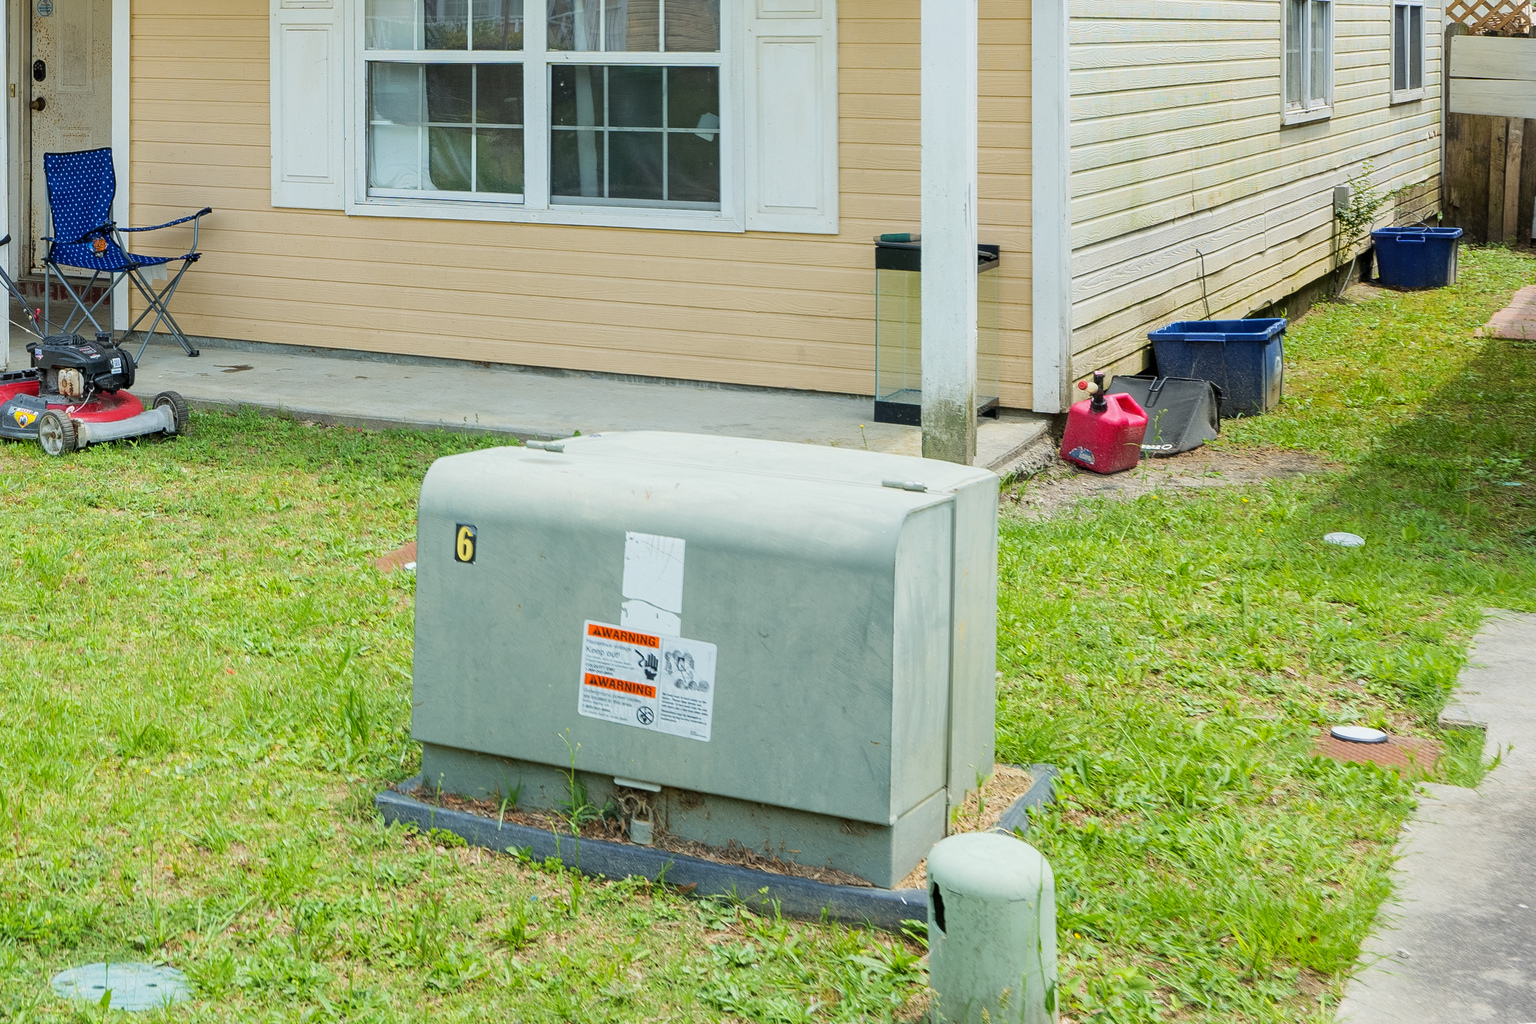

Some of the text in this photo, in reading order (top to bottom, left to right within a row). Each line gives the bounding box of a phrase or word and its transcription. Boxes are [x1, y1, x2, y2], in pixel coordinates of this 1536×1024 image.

[457, 526, 474, 562] 6
[601, 626, 657, 647] WARNING
[597, 675, 653, 697] WARNING
